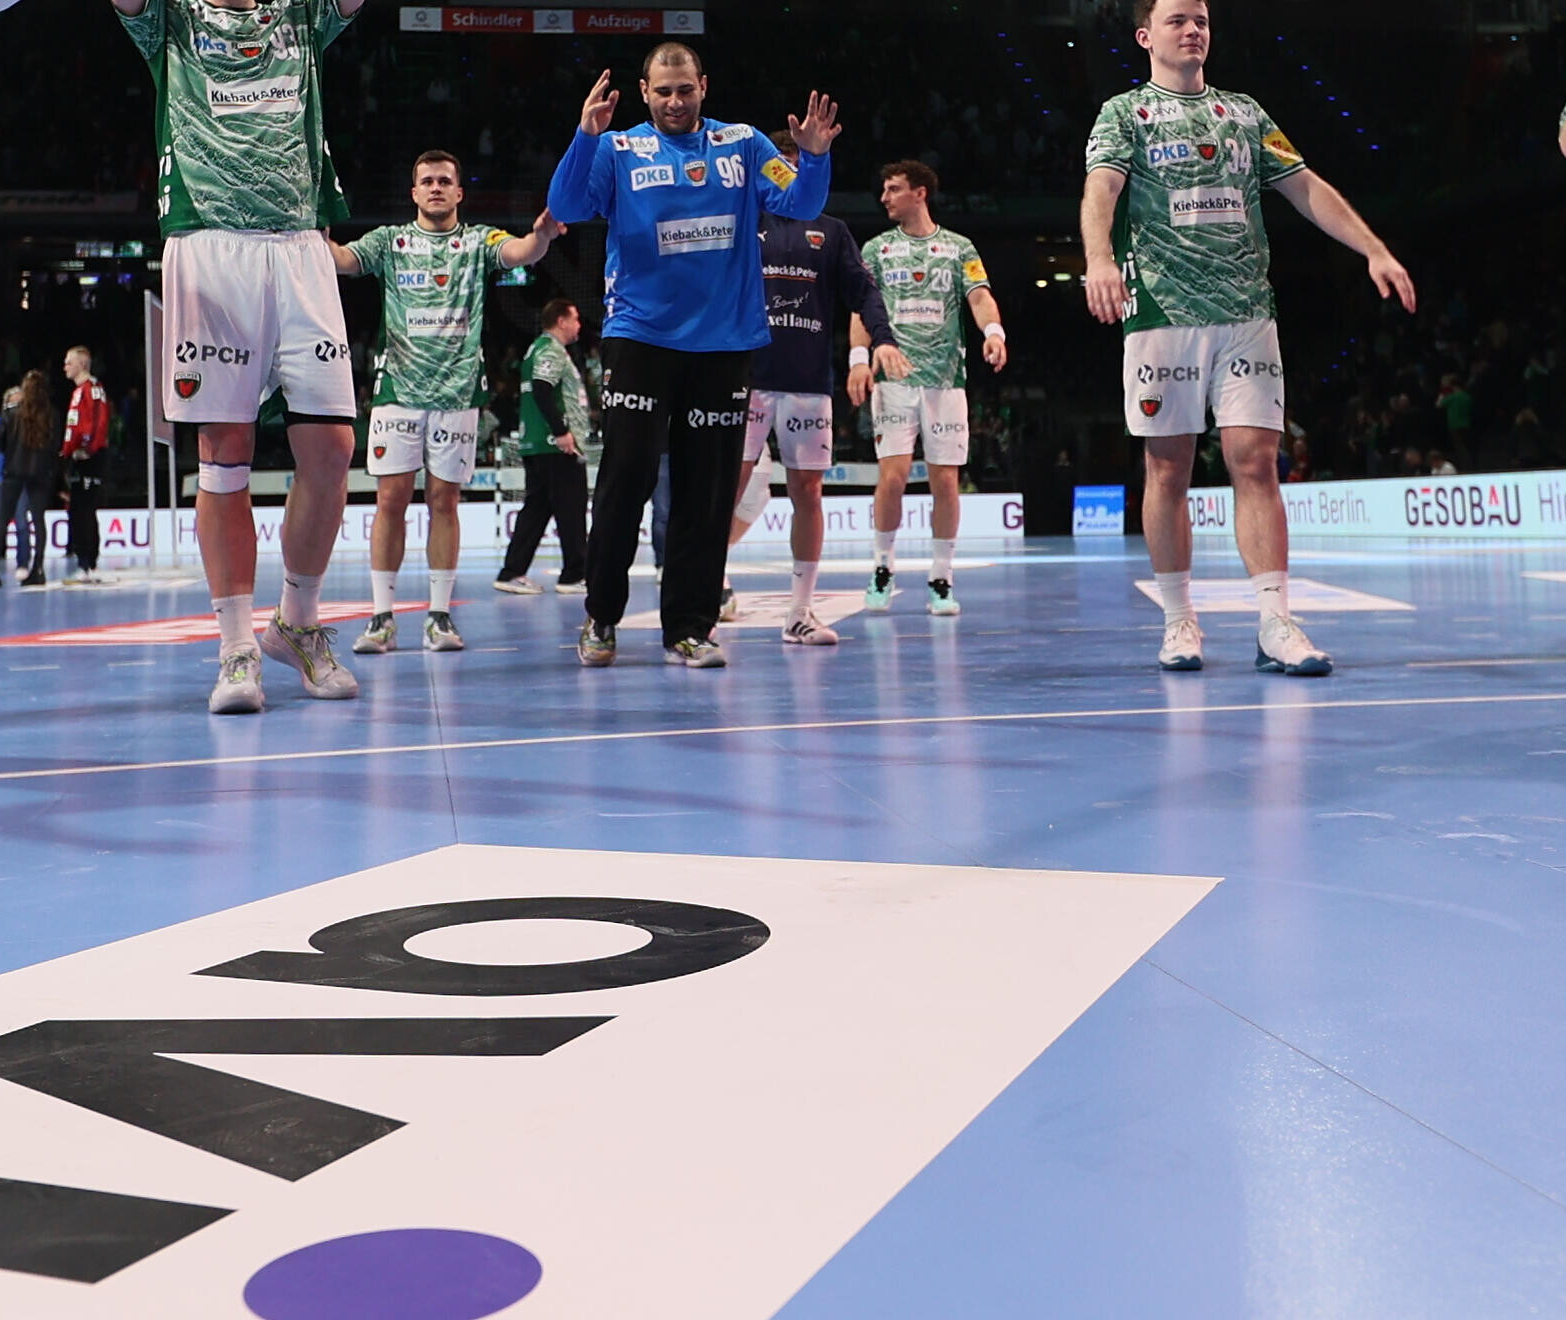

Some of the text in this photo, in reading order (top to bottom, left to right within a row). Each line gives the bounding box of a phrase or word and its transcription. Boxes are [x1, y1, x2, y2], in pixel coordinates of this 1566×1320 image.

[452, 12, 651, 31] Schindler Aufzüge
[1149, 143, 1190, 164] DKB
[1224, 138, 1252, 176] 34
[634, 168, 670, 186] DKB
[715, 154, 746, 189] 96
[397, 273, 426, 285] DKB
[201, 346, 250, 366] PCH
[1157, 366, 1200, 382] PCH
[612, 391, 653, 412] PCH
[707, 410, 744, 427] PCH
[746, 410, 765, 424] CH
[385, 421, 417, 434] PCH
[1318, 490, 1371, 525] Berlin.
[1404, 483, 1522, 527] GESOBAU
